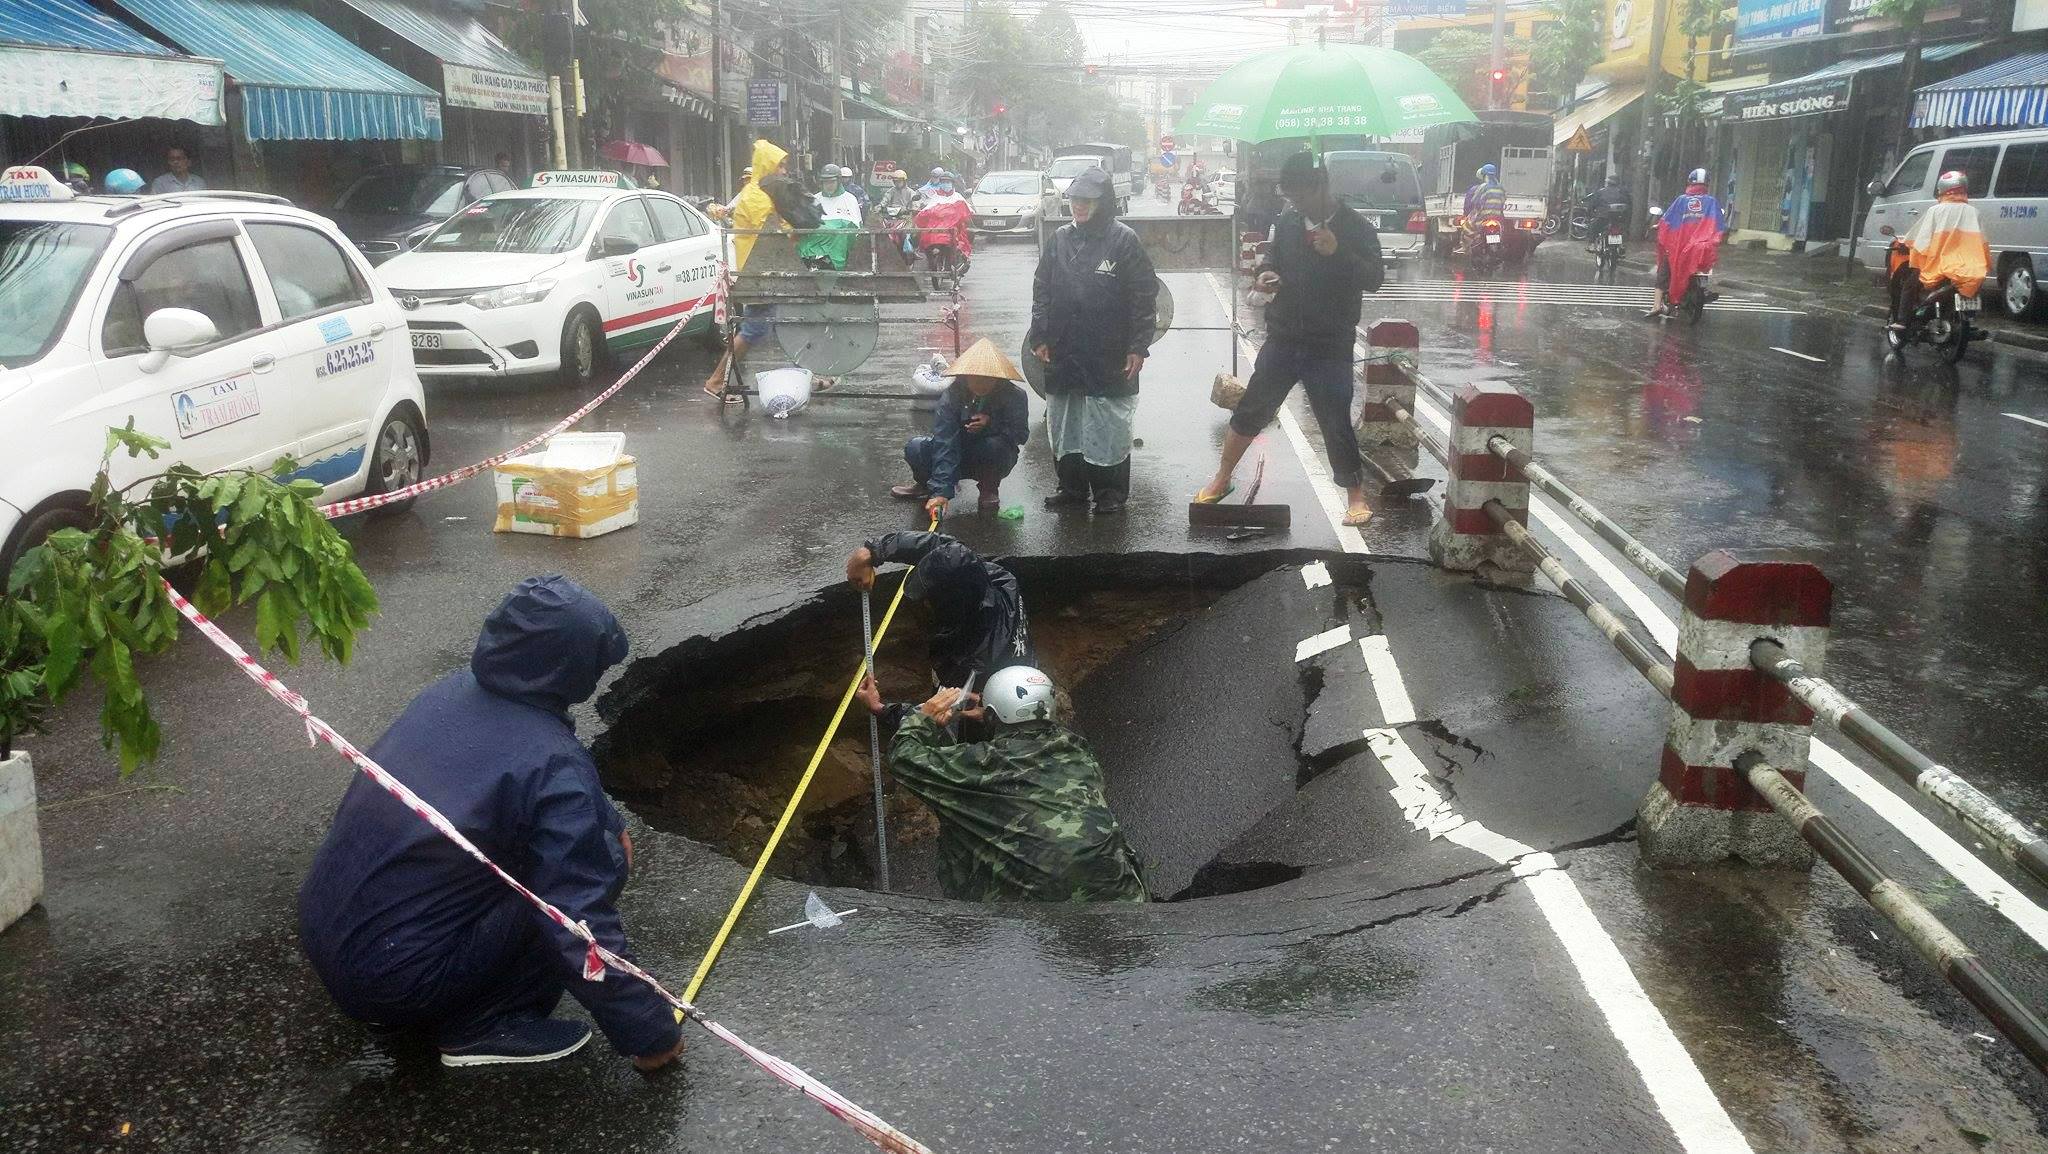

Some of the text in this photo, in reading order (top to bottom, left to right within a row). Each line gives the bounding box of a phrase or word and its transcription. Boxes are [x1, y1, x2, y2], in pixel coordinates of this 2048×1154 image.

[1337, 104, 1362, 113] TRANG
[9, 171, 39, 180] TAXI
[554, 174, 618, 184] VINASUN TAXI
[626, 288, 654, 301] VINASUN
[210, 380, 239, 397] TAXI
